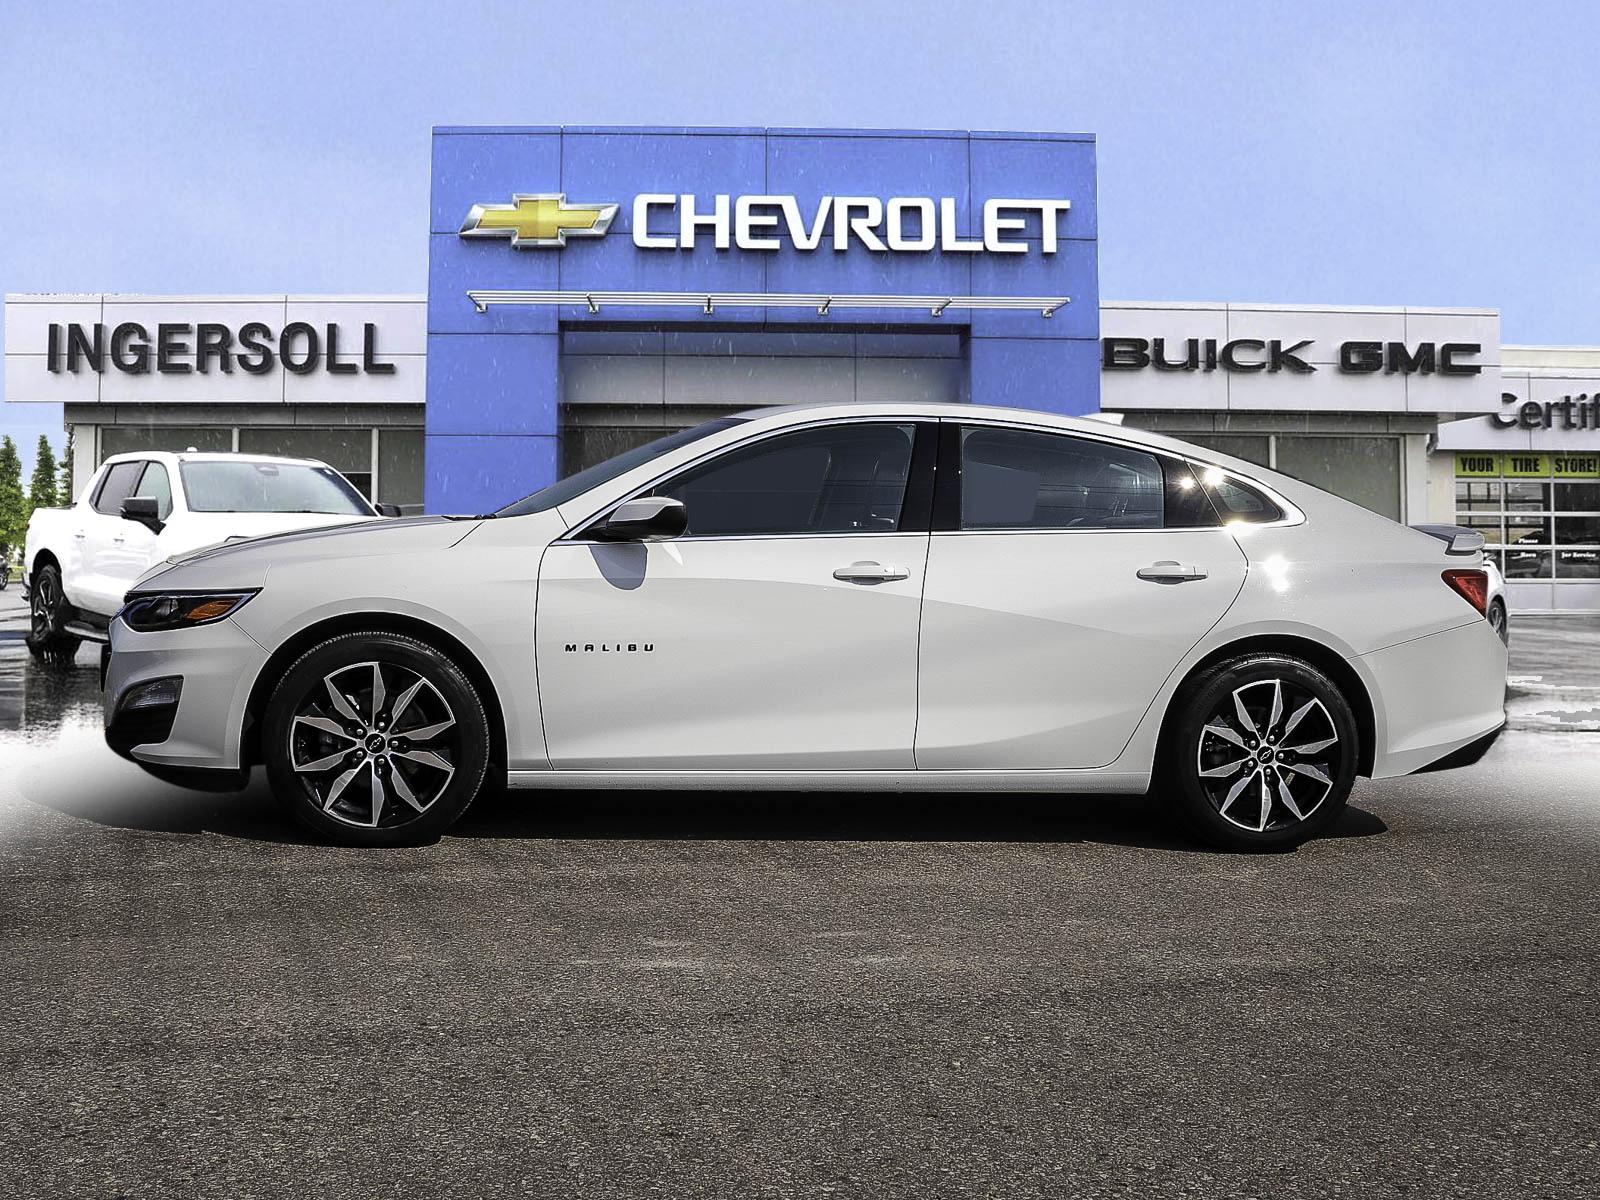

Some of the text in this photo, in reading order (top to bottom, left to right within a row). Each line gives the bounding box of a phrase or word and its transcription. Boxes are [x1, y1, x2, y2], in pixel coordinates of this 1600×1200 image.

[632, 193, 1071, 254] CHEVROLET
[47, 321, 395, 375] INGERSOLL
[1101, 336, 1482, 375] BUICK GMC
[1460, 457, 1597, 473] YOUR TIRE STORE!
[565, 644, 654, 652] MALIBU
